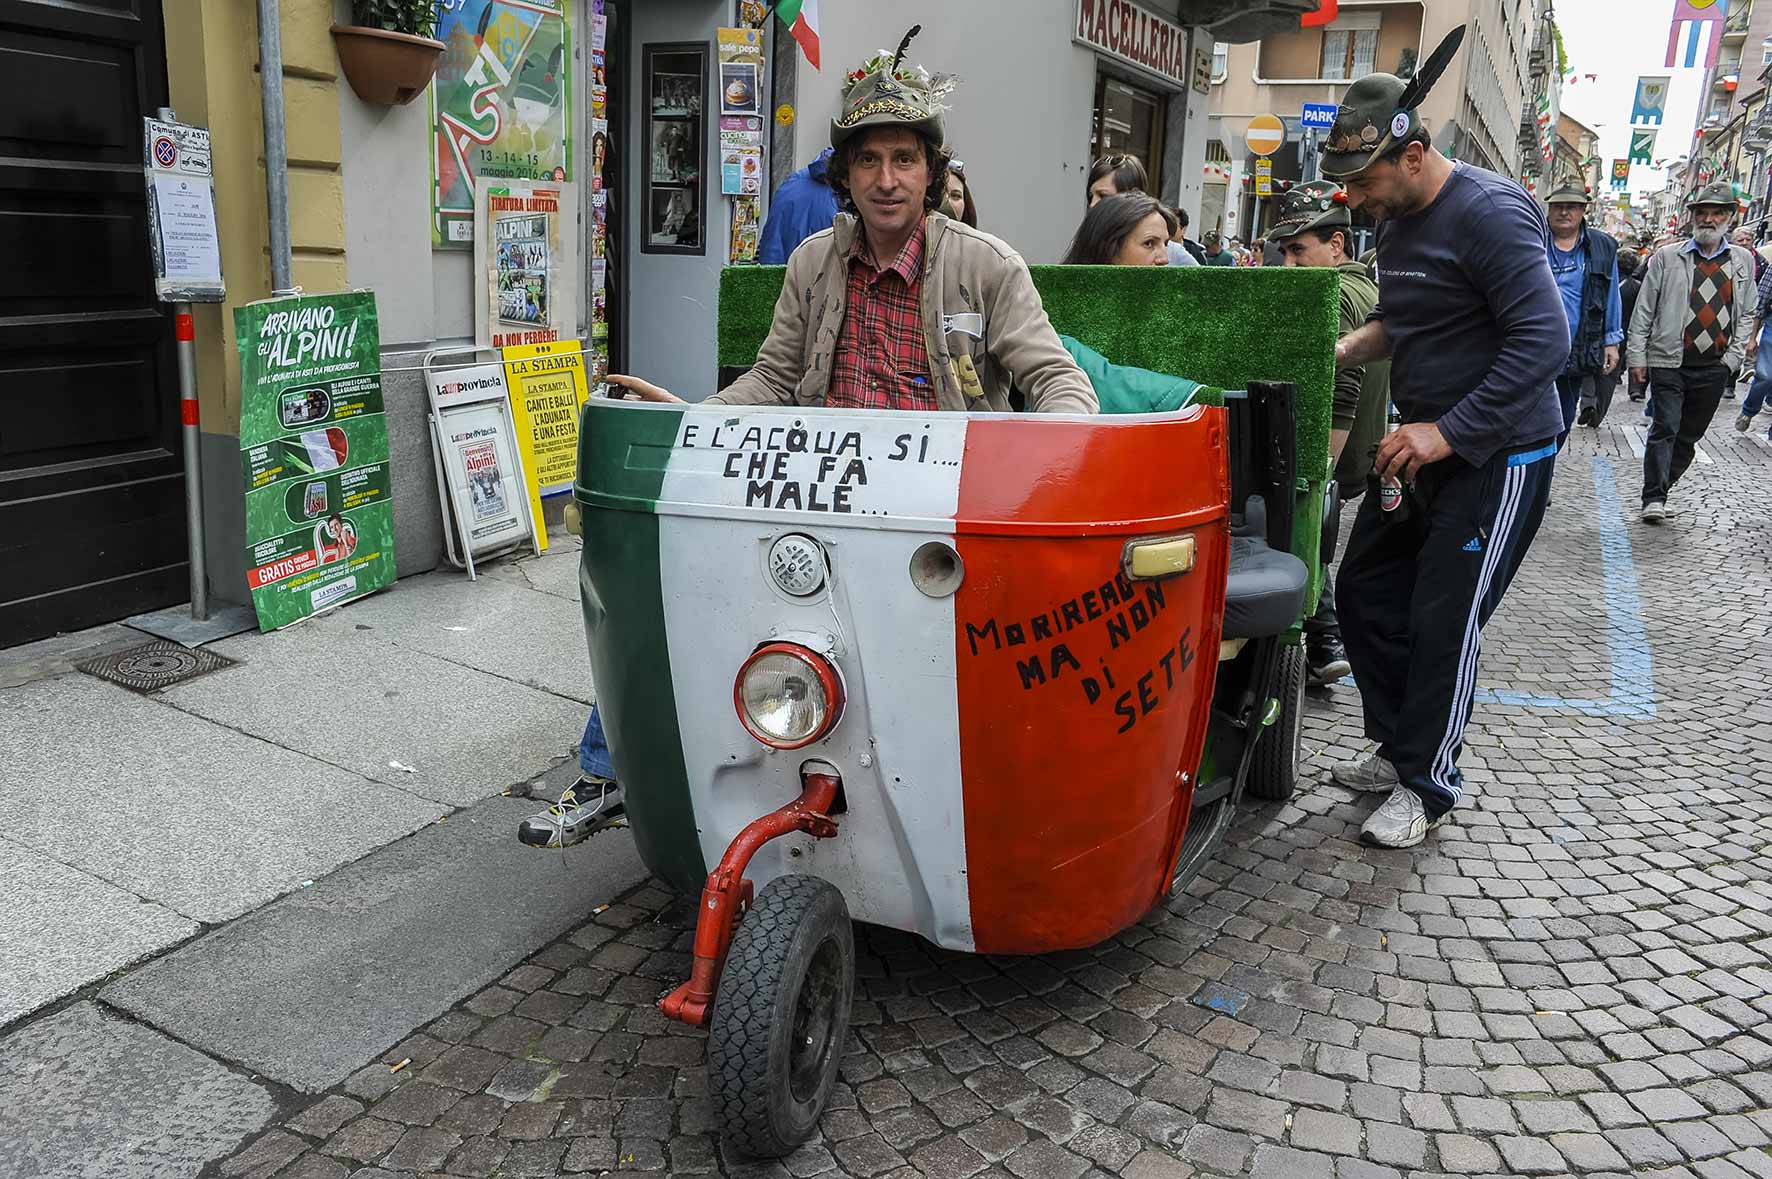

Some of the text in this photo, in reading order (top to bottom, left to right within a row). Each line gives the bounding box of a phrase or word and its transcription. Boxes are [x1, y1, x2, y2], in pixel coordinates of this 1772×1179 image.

[1078, 0, 1184, 81] MACELLERIA
[1304, 110, 1335, 122] PARK
[191, 131, 209, 140] ASTI
[480, 150, 493, 161] 13
[504, 151, 516, 163] 14
[527, 153, 539, 165] 15
[480, 166, 538, 179] maggio 2016
[491, 196, 558, 212] TIRATURA LIMITATA
[260, 305, 335, 338] ARRIVANO
[257, 317, 358, 369] GLI ALPINI!
[493, 334, 504, 347] DA
[505, 332, 522, 346] NON
[301, 368, 313, 377] ASTI
[511, 356, 578, 374] LA STAMPA
[528, 381, 568, 393] LA STAMPA
[526, 394, 574, 413] CANTI E BALLI
[533, 408, 572, 426] L'ADUNATA
[540, 425, 556, 440] UNA
[555, 422, 577, 438] FESTA
[682, 425, 700, 448] E
[466, 453, 497, 471] Alpini!
[722, 450, 868, 486] CHE FA
[258, 559, 295, 584] GRATIS
[319, 583, 348, 598] LA STAMPA
[1016, 578, 1166, 690] MA NON
[1114, 626, 1195, 734] SETE
